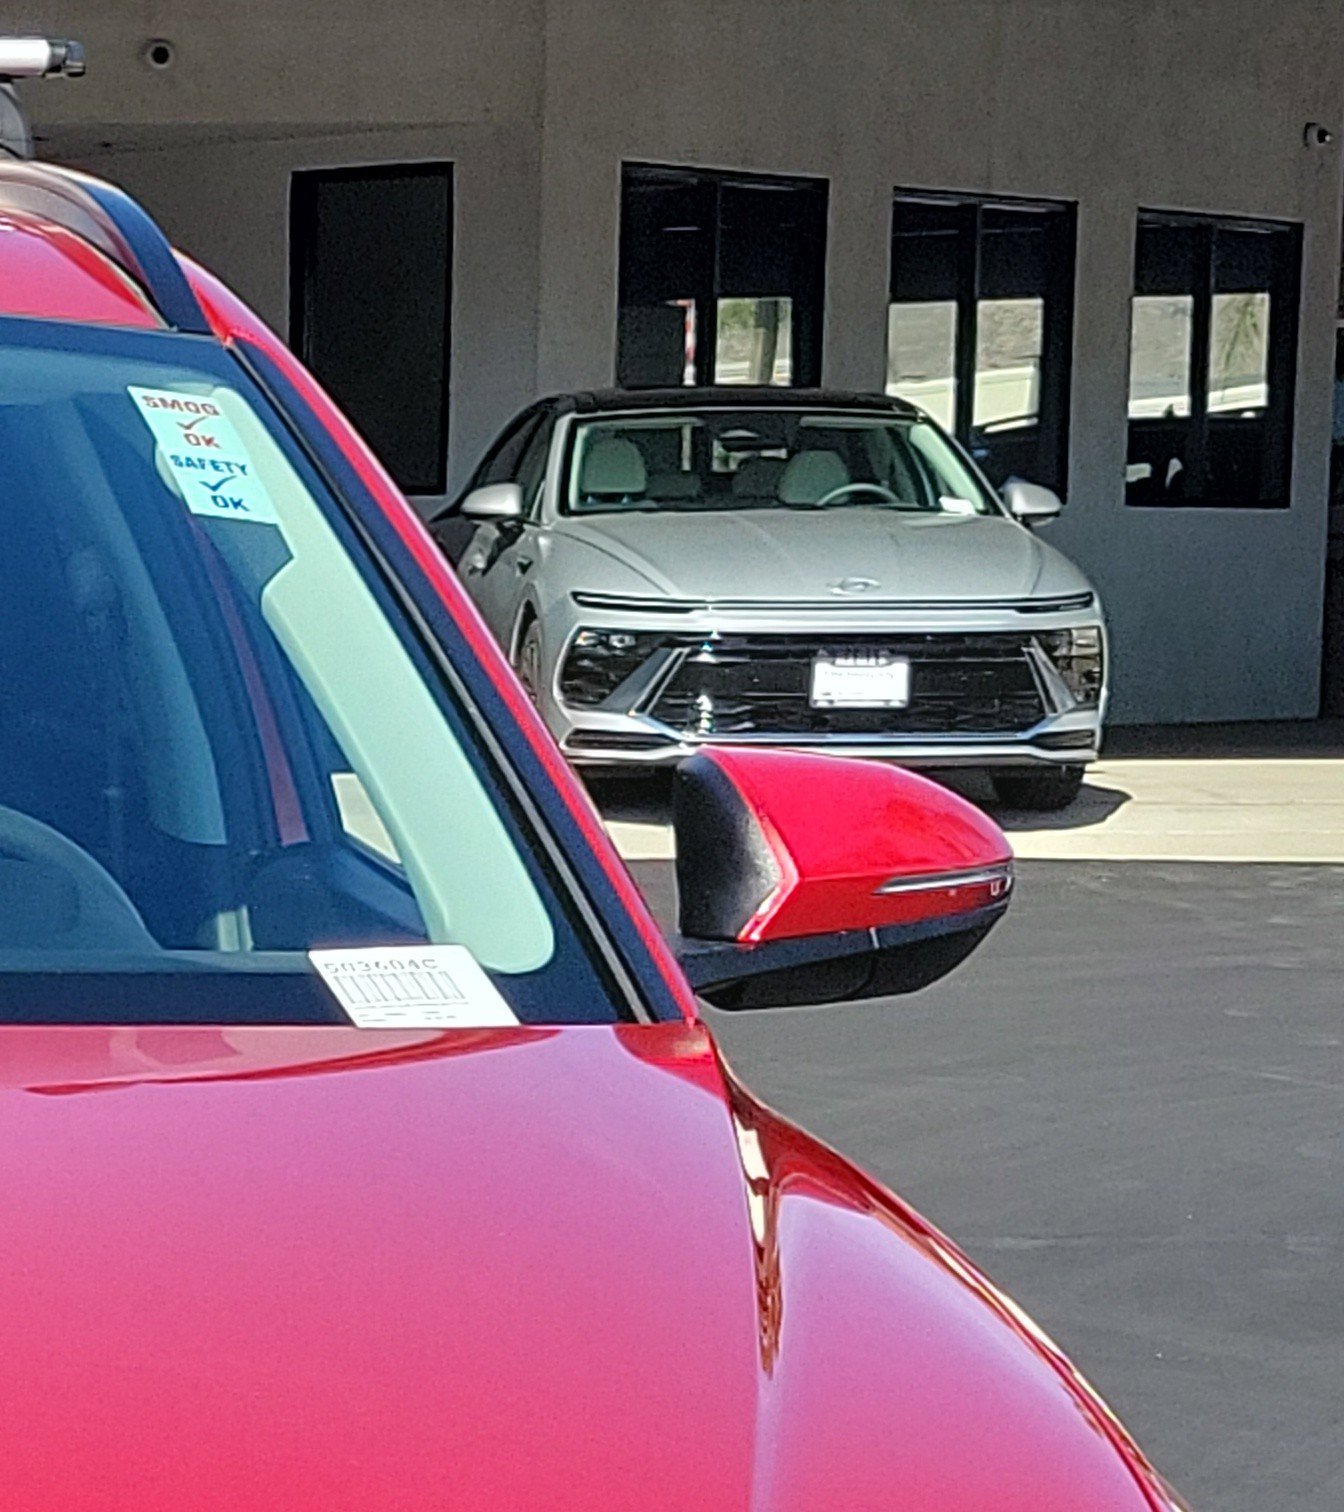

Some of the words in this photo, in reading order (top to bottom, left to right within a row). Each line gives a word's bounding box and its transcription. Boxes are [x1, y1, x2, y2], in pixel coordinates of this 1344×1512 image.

[141, 395, 220, 416] SMOG
[183, 433, 222, 449] OK
[169, 454, 249, 476] SAFETY
[210, 495, 250, 512] OK
